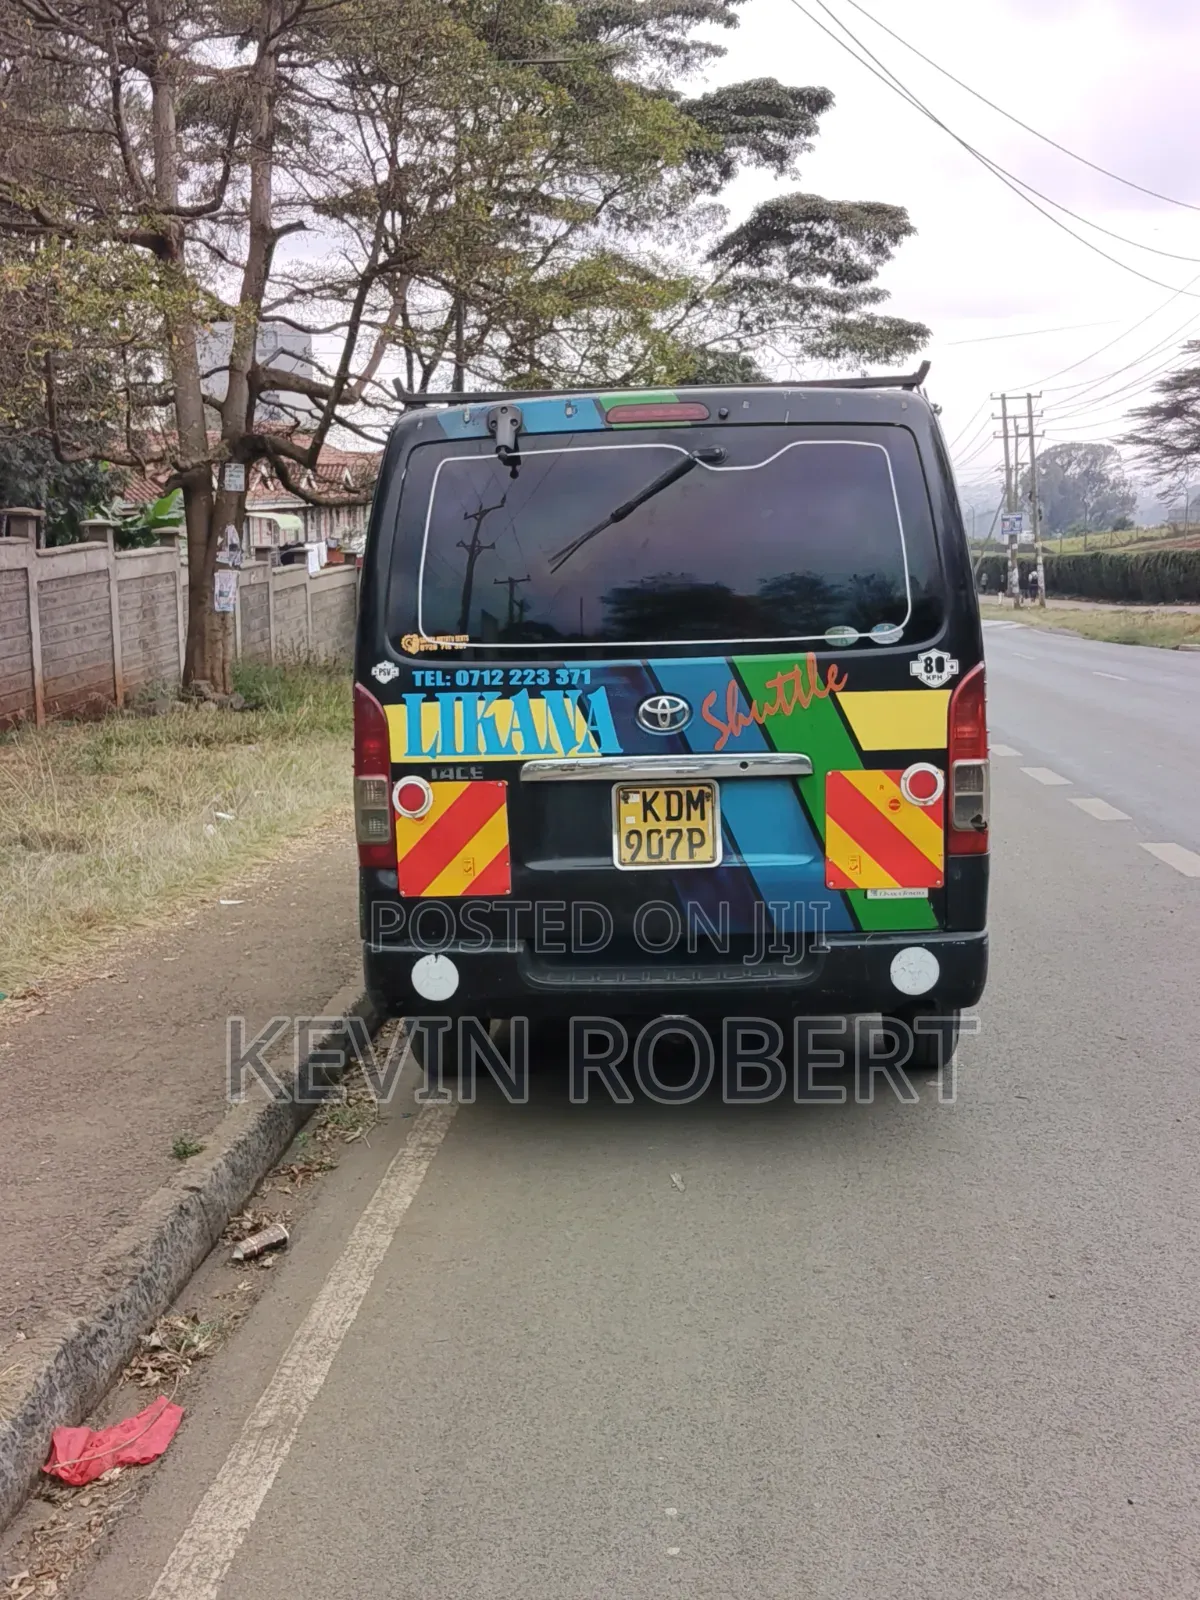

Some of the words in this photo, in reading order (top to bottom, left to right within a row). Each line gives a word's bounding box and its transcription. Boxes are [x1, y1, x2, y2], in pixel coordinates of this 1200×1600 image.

[378, 667, 391, 676] PSV
[923, 656, 945, 674] 80
[412, 670, 451, 687] TEL:
[455, 669, 504, 686] 0712
[509, 669, 550, 686] 223
[555, 669, 591, 685] 371
[701, 652, 848, 751] Shuttle
[641, 789, 706, 823] KDM
[624, 828, 706, 861] 907P
